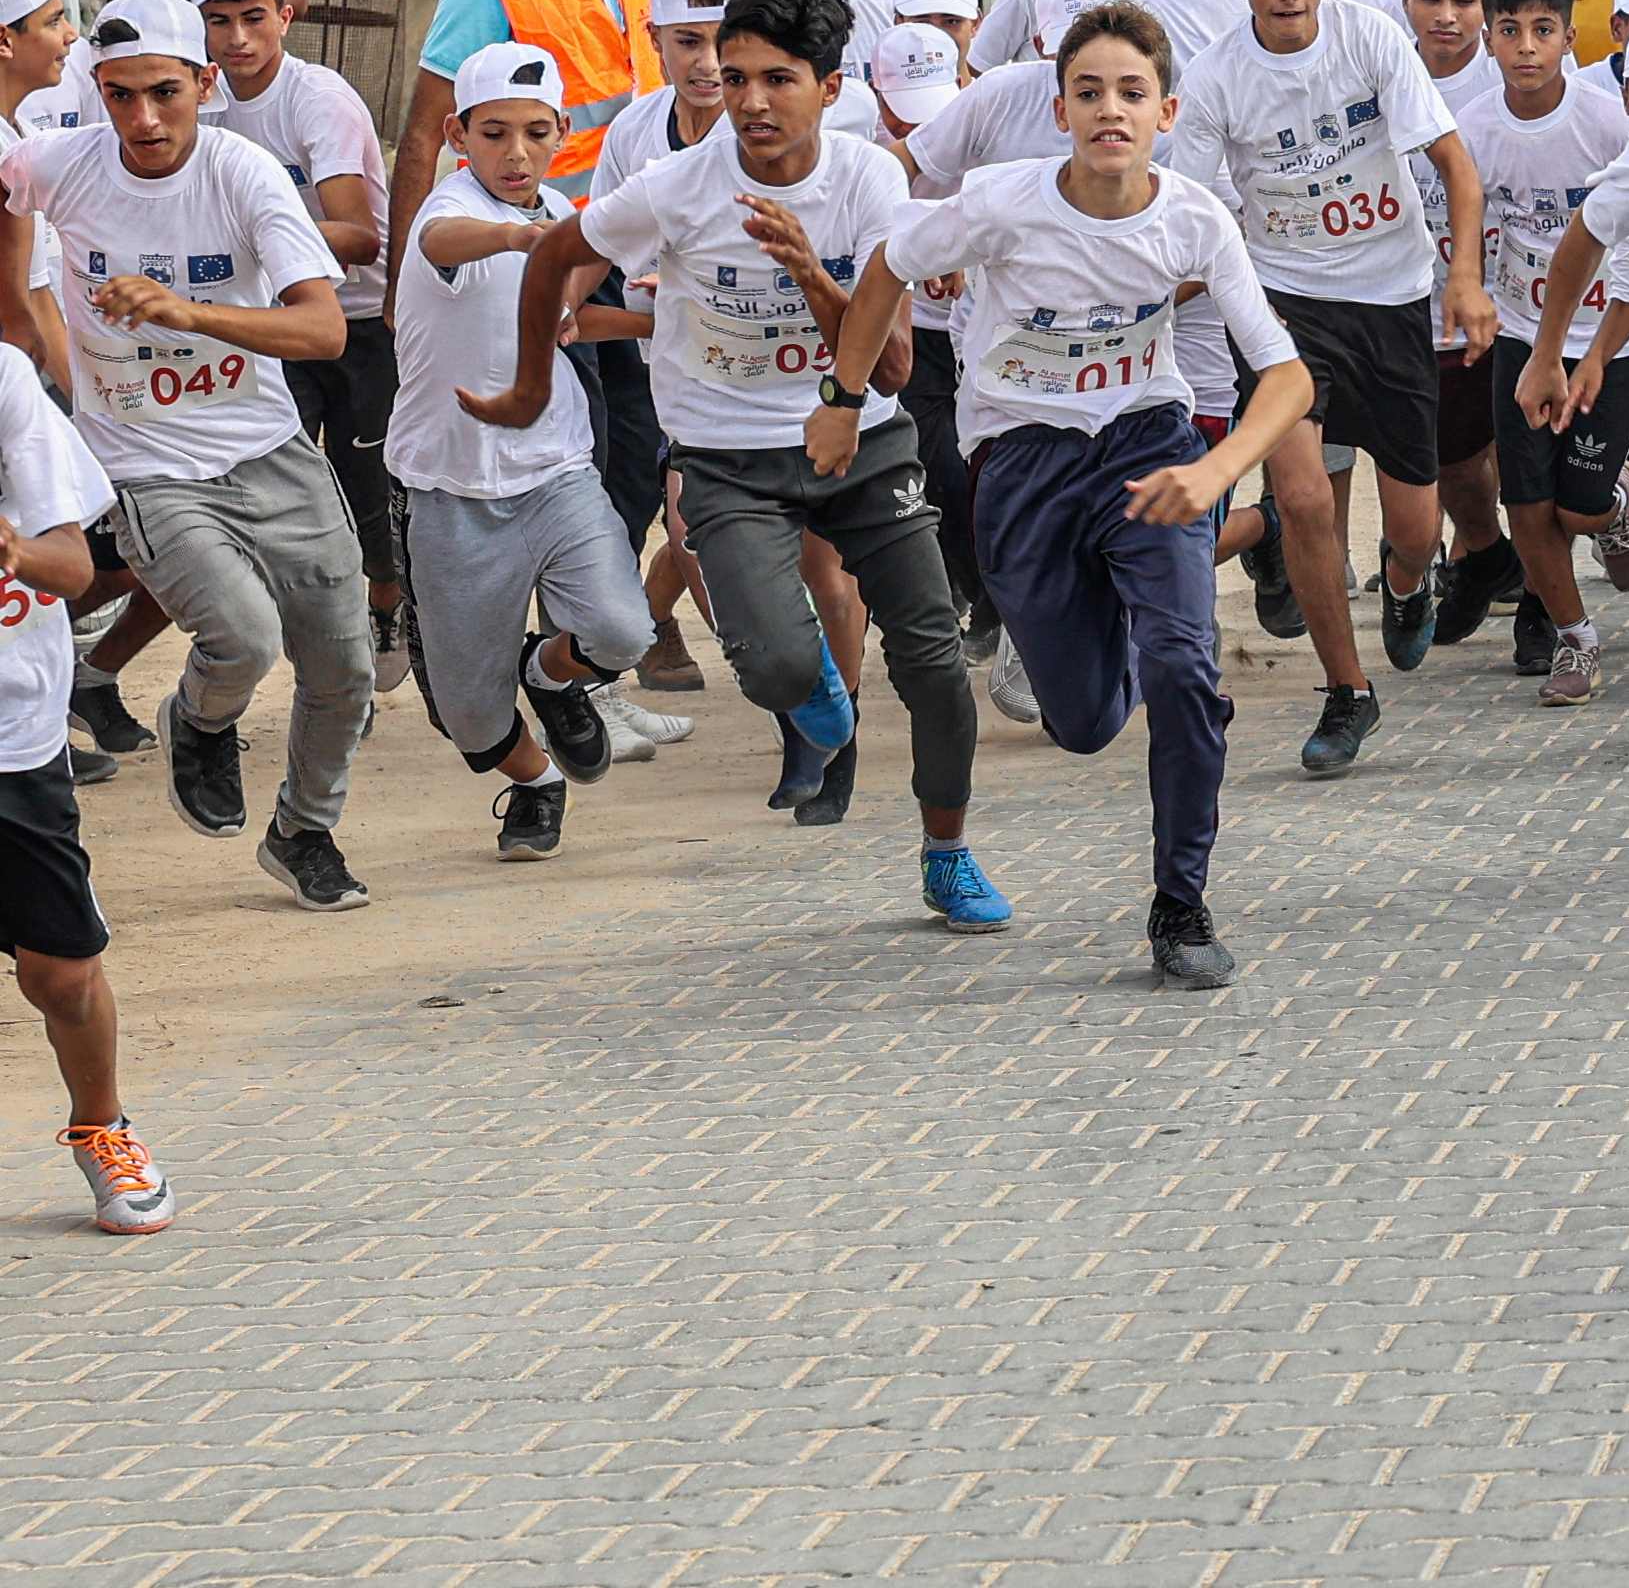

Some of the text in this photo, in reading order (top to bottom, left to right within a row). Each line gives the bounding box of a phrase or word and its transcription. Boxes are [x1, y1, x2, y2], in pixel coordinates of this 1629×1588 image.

[1321, 182, 1401, 237] 036
[150, 353, 246, 406] 049
[775, 342, 836, 374] 05
[1076, 338, 1157, 393] 019
